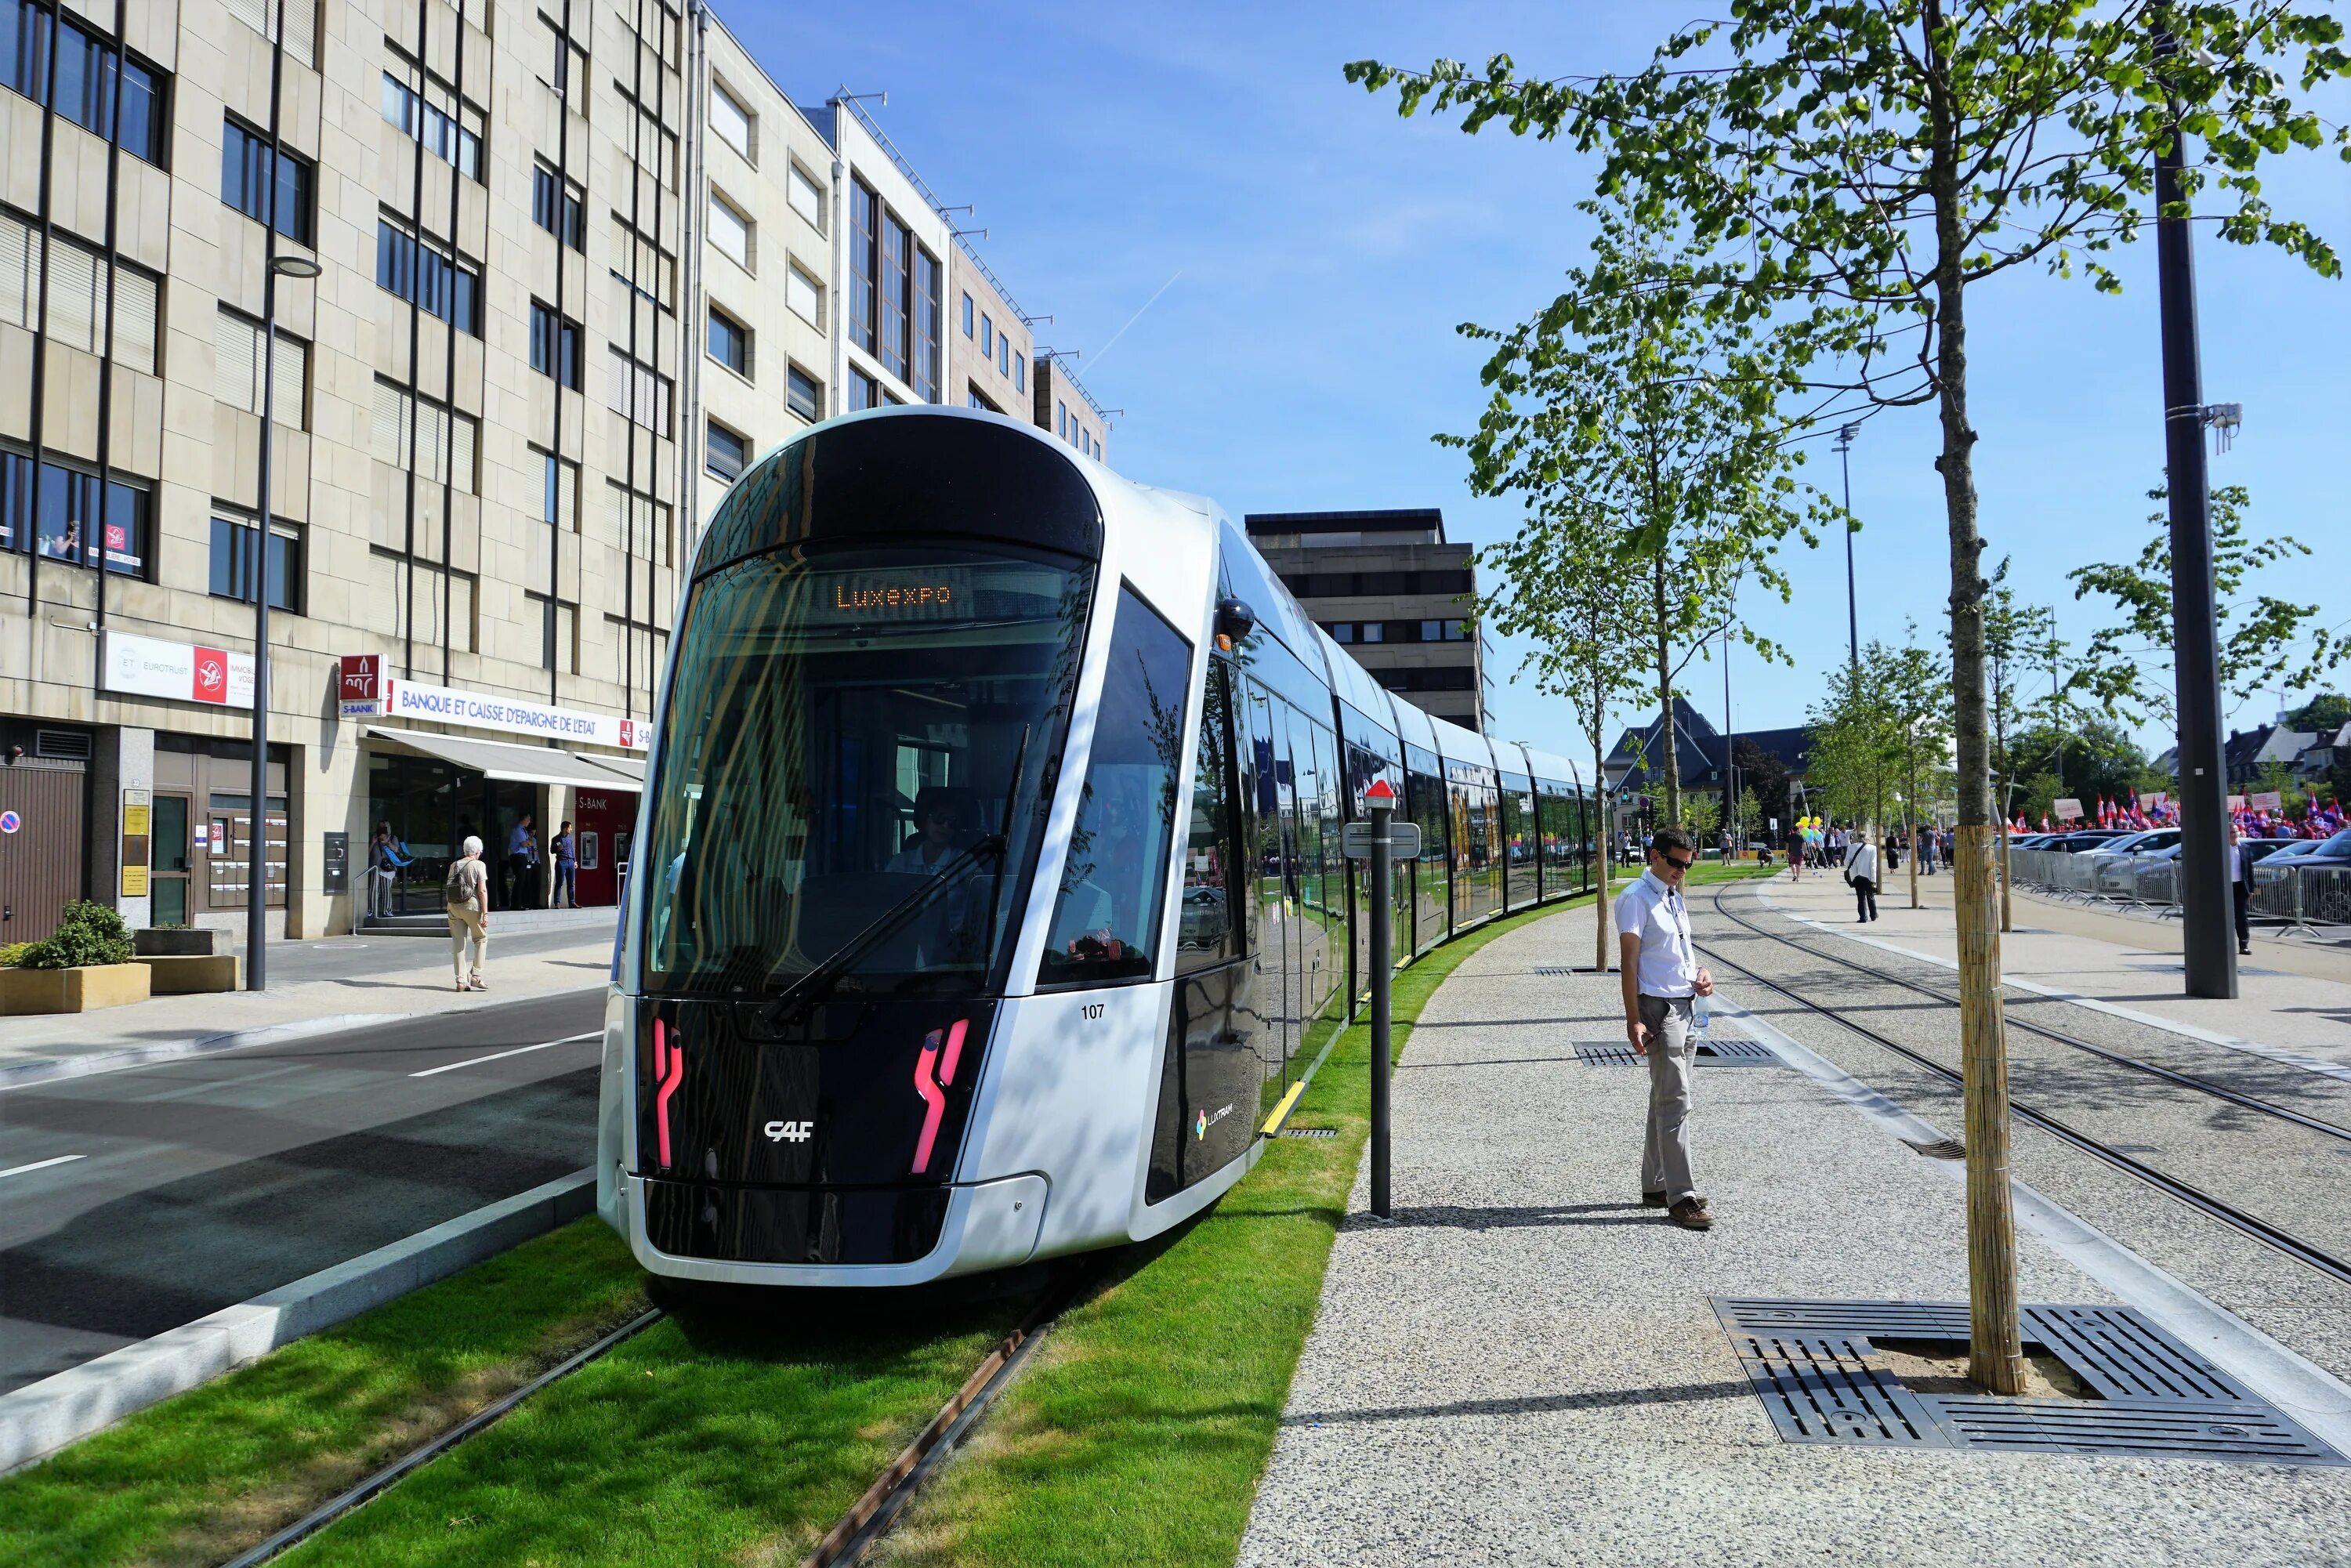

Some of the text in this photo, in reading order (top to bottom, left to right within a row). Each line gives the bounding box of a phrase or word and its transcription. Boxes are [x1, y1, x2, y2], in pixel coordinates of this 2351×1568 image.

[838, 586, 950, 607] Luxexpo
[144, 662, 188, 675] EUROTRUST
[230, 664, 255, 675] IMMOBIL
[343, 704, 373, 713] S-BANK
[402, 690, 596, 735] BANQUE ET CAISSE D'EPARGNE DE L'ETAT
[639, 730, 651, 744] S-B
[579, 797, 607, 810] S-BANK
[1081, 1004, 1104, 1019] 107
[1208, 1103, 1233, 1125] LUXTRAM
[764, 1121, 813, 1142] CAF
